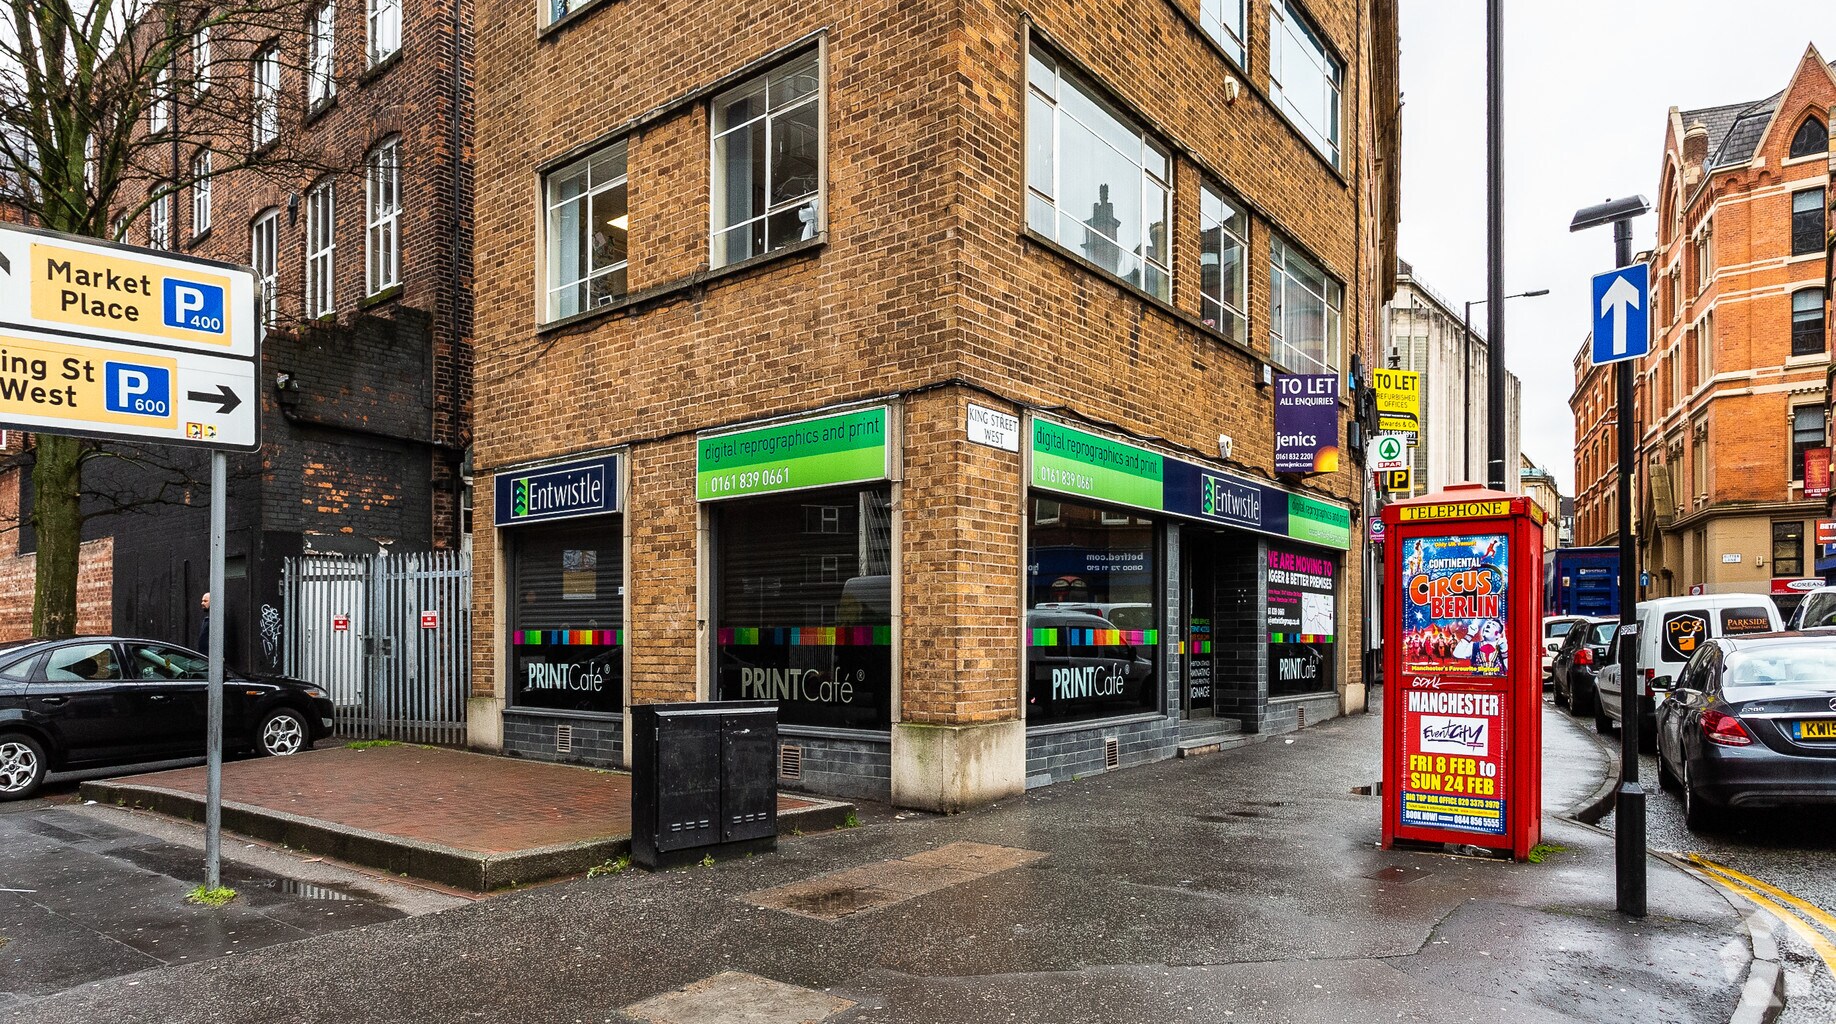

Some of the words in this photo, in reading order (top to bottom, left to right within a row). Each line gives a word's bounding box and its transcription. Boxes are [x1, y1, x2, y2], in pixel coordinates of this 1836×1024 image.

[47, 258, 151, 297] Market
[61, 290, 139, 321] Place
[175, 285, 204, 323] P
[190, 316, 220, 330] 400
[0, 350, 47, 381] ing
[62, 357, 95, 382] St
[0, 379, 77, 407] West
[118, 369, 149, 408] P
[1279, 378, 1302, 394] TO
[1307, 378, 1335, 394] LET
[1376, 374, 1391, 389] TO
[1395, 375, 1417, 391] LET
[135, 399, 166, 414] 600
[1280, 397, 1293, 405] ALL
[1295, 397, 1333, 406] ENQUIRIES
[1377, 392, 1415, 401] REFURBISHED
[1384, 401, 1408, 409] OFFICES
[968, 407, 989, 425] KING
[991, 413, 1017, 433] STREET
[705, 440, 737, 463] digital
[739, 427, 819, 458] reprographics
[822, 422, 845, 440] and
[848, 417, 880, 442] print
[984, 428, 1004, 445] WEST
[1276, 431, 1317, 451] jenics
[1036, 426, 1065, 452] digital
[1066, 437, 1124, 466] reprographics
[1125, 452, 1139, 469] and
[1140, 457, 1158, 474] print
[711, 474, 737, 493] 0161
[739, 471, 759, 489] 839
[762, 467, 789, 486] 0661
[1041, 465, 1060, 483] 0161
[1061, 471, 1075, 487] 839
[1076, 476, 1094, 490] 0661
[1393, 472, 1407, 488] P
[529, 473, 601, 511] Entwistle
[1215, 484, 1259, 521] Entwistle
[1407, 502, 1503, 520] TELEPHONE
[1280, 552, 1294, 571] ARE
[1295, 555, 1322, 575] MOVING
[1323, 560, 1333, 576] TO
[1429, 557, 1481, 569] CONTINENTAL
[1268, 569, 1285, 584] IGGER
[1290, 573, 1309, 587] BETTER
[1309, 575, 1332, 590] PREMISES
[1409, 570, 1492, 606] CIRCUS
[1430, 595, 1499, 619] BERLIN
[1670, 620, 1703, 633] PCS
[1727, 618, 1768, 627] PARKSIDE
[1191, 685, 1210, 698] IGNAGE
[1408, 691, 1499, 716] MANCHESTER
[1409, 754, 1433, 772] FRI
[1435, 756, 1446, 773] 8
[1449, 757, 1476, 775] FEB
[1478, 760, 1496, 777] to
[1410, 772, 1441, 790] SUN
[1444, 775, 1464, 793] 24
[1467, 777, 1494, 795] FEB
[1405, 793, 1416, 801] BIG
[1416, 794, 1427, 802] TOP
[1427, 795, 1439, 803] BOX
[1439, 796, 1457, 805] OFFICE
[1457, 797, 1469, 806] 020
[1405, 810, 1422, 820] BOOK
[1422, 812, 1438, 821] NOW!
[1454, 815, 1470, 825] 0844
[1470, 816, 1482, 826] 856
[1483, 818, 1500, 828] 5555
